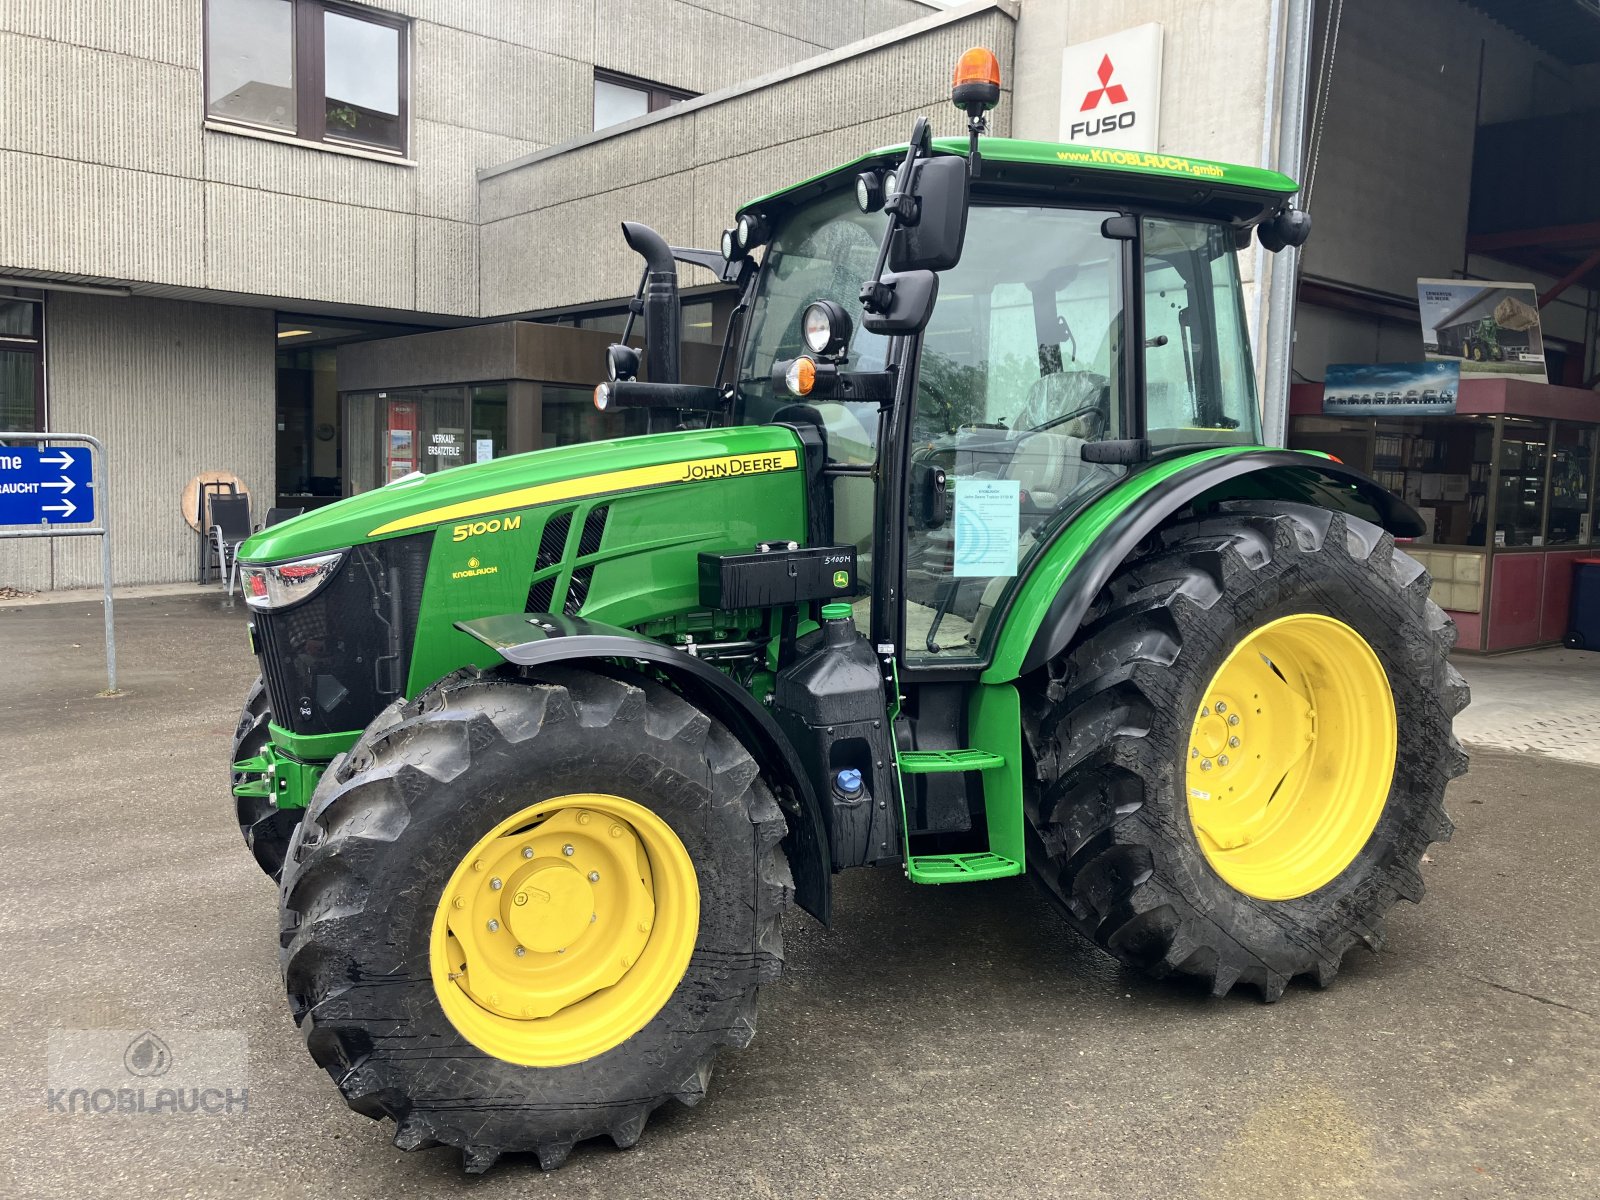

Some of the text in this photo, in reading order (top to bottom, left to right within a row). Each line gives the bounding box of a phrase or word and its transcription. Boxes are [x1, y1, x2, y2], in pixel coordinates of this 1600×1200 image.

[1070, 110, 1136, 140] FUSO
[1056, 149, 1224, 177] www.KNOBLAUCH.gmbh
[431, 433, 456, 444] VERKAUF
[427, 446, 460, 456] ERSATZTEILE
[682, 457, 782, 479] JOHN DEERE
[0, 482, 40, 494] AUCHT
[453, 515, 521, 542] 5100 M
[452, 566, 498, 579] KNOBLAUCH
